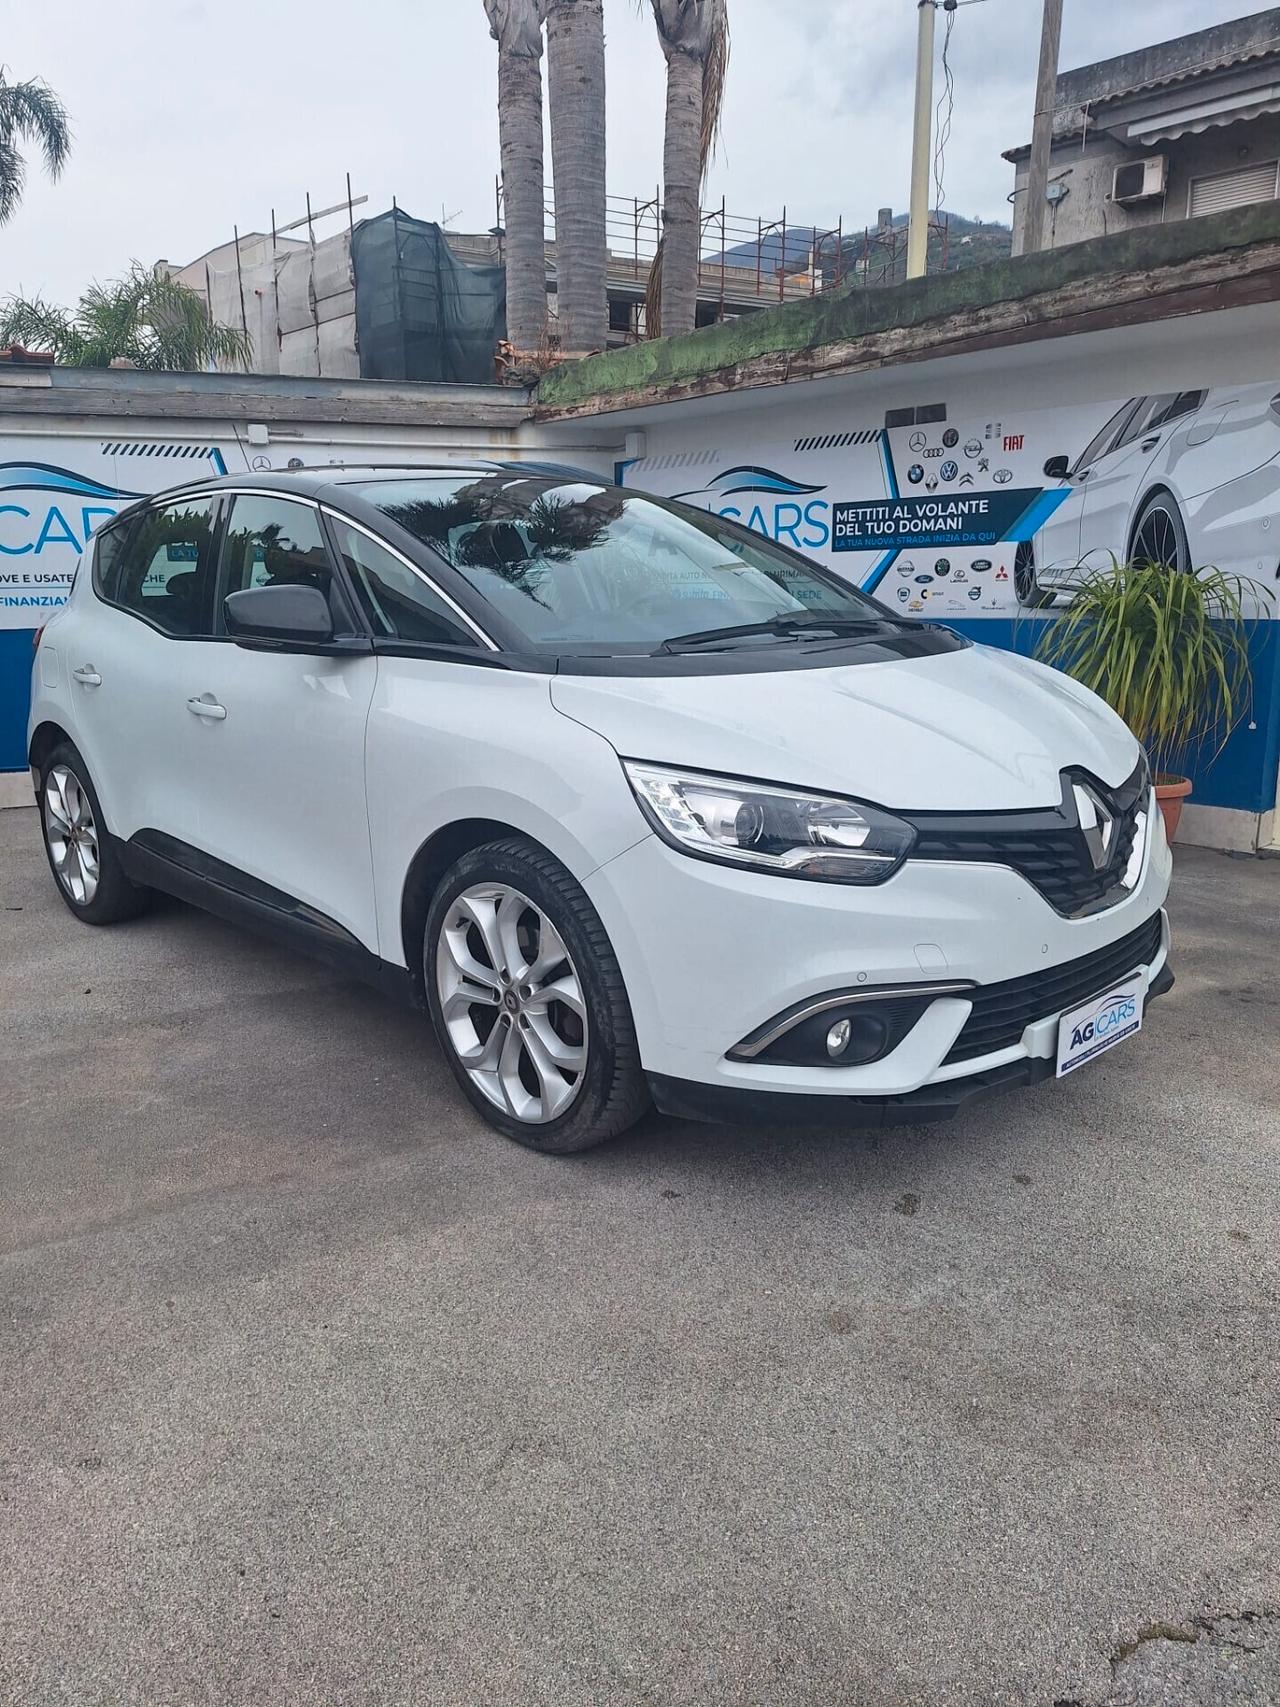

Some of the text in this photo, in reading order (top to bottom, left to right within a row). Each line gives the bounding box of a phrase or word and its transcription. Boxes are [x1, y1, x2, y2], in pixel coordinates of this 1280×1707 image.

[1003, 435, 1024, 452] FIAT
[836, 500, 989, 522] METTITI AL VOLANTE
[836, 517, 962, 536] DEL TUO DOMANI
[865, 536, 894, 545] NUOVA
[896, 534, 930, 544] STRADA
[933, 533, 959, 542] INIZIA
[962, 533, 976, 541] DA
[978, 531, 996, 541] QUI
[0, 574, 74, 583] VE E USATE
[0, 597, 68, 606] INANZIA
[797, 590, 822, 600] SEDE
[1069, 1021, 1094, 1050] AG
[1096, 999, 1135, 1034] CARS
